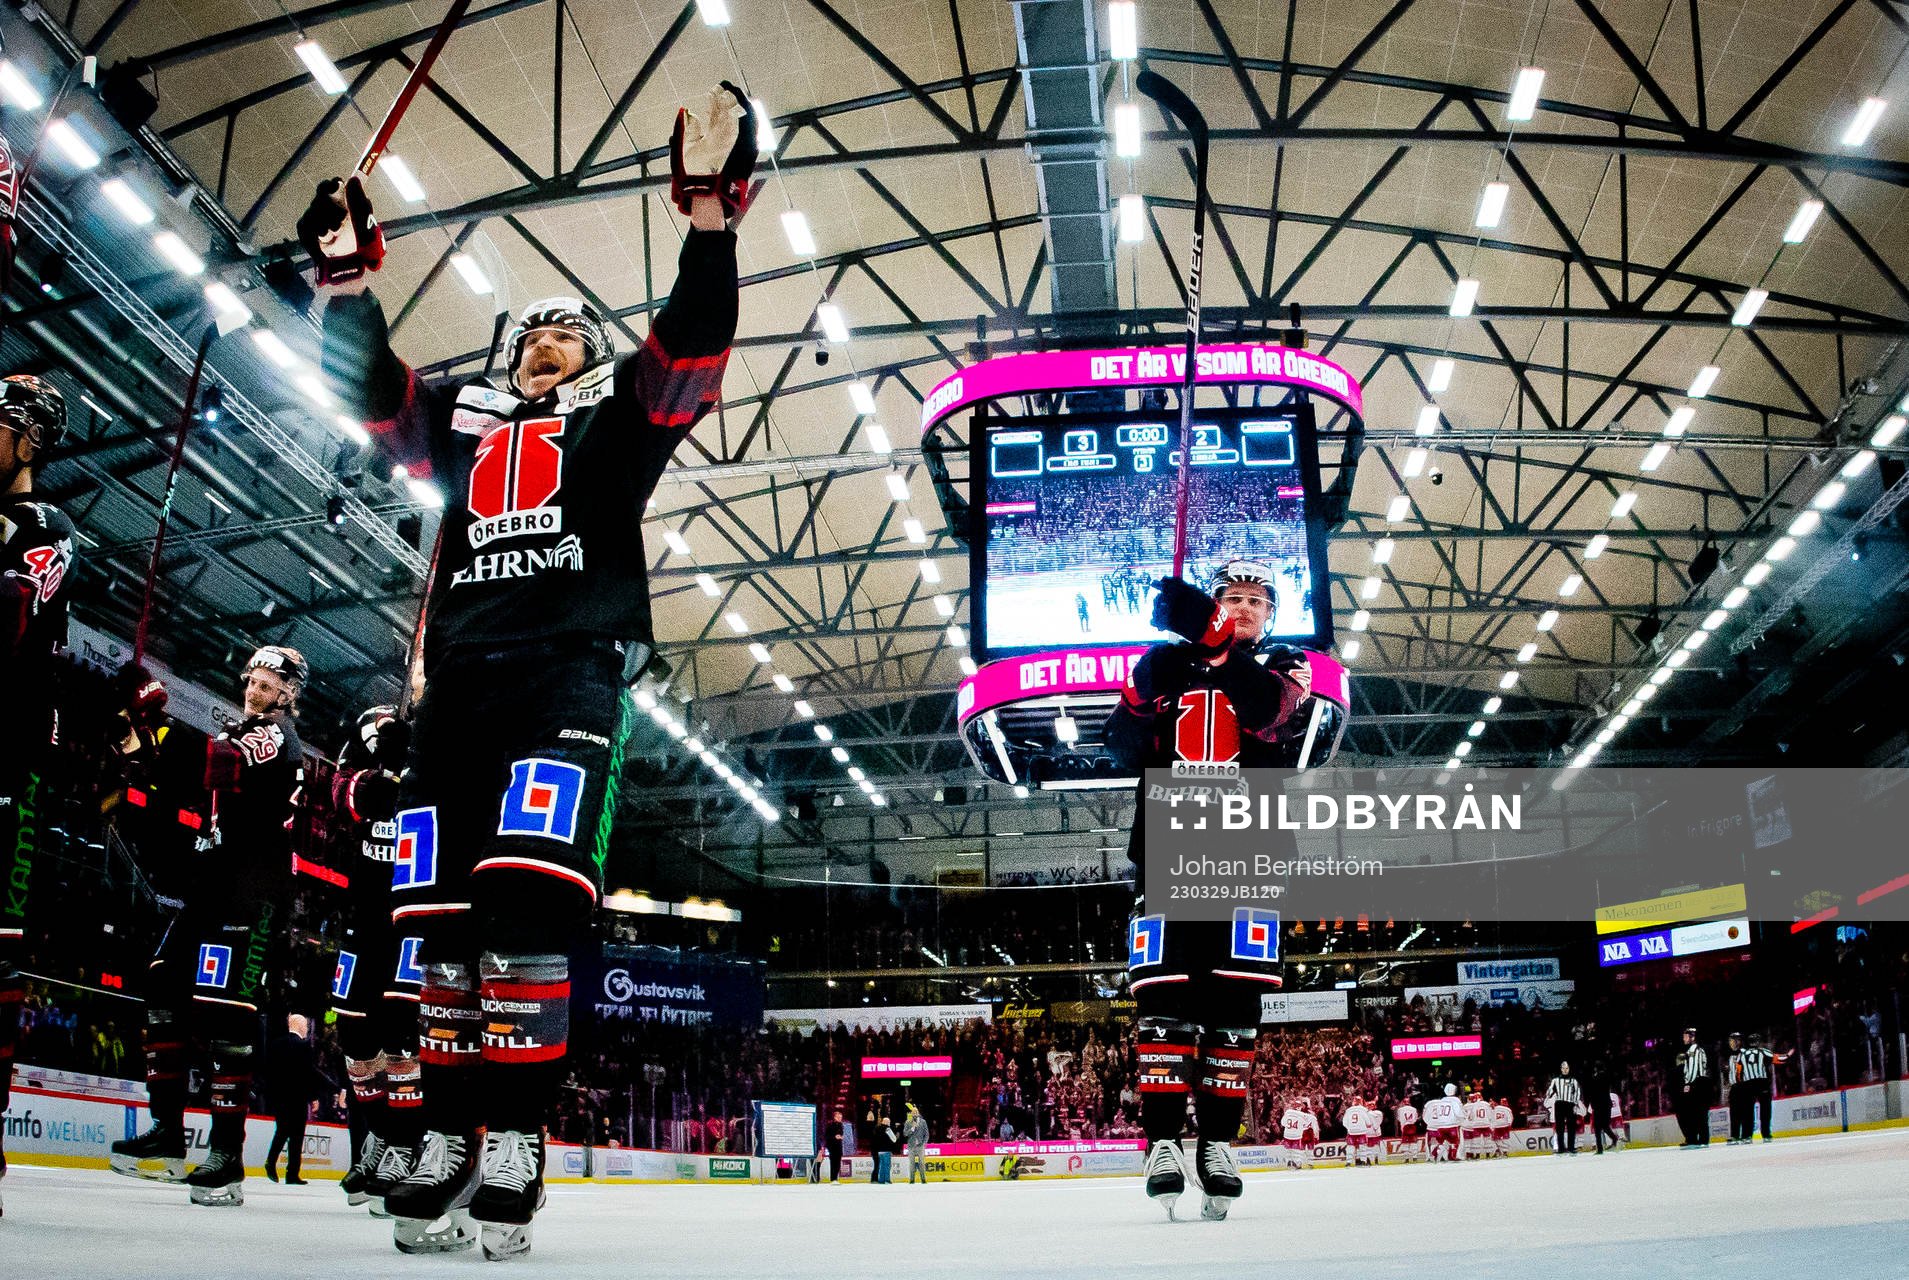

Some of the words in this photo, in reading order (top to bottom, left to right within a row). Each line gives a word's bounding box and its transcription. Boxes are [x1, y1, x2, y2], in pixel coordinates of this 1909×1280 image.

[1187, 233, 1202, 333] BAUER
[1091, 355, 1133, 380] DET
[1137, 351, 1168, 378] ÄR
[1172, 353, 1187, 377] V
[1197, 351, 1247, 377] SOM
[1252, 348, 1281, 376] ÄR
[1284, 351, 1349, 397] ÖREBRO
[1078, 435, 1089, 451] 3
[1129, 428, 1160, 442] 0:00
[1196, 431, 1207, 445] 2
[474, 513, 554, 542] ÖREBRO
[1020, 659, 1061, 690] DET
[1066, 653, 1097, 684] ÄR
[1100, 654, 1125, 682] VI
[243, 726, 277, 764] 29
[558, 729, 610, 748] BAUER
[1178, 762, 1237, 776] ÖREBRO
[1605, 899, 1682, 921] Mekonomen
[1681, 930, 1726, 945] Swedbank
[1603, 942, 1632, 962] NA
[1639, 936, 1669, 956] NA
[1464, 961, 1554, 979] Vintergatan
[604, 968, 706, 1002] Gustavsvik
[1140, 1074, 1185, 1084] STILL
[1203, 1077, 1247, 1089] STILL
[47, 1119, 106, 1144] WELINS
